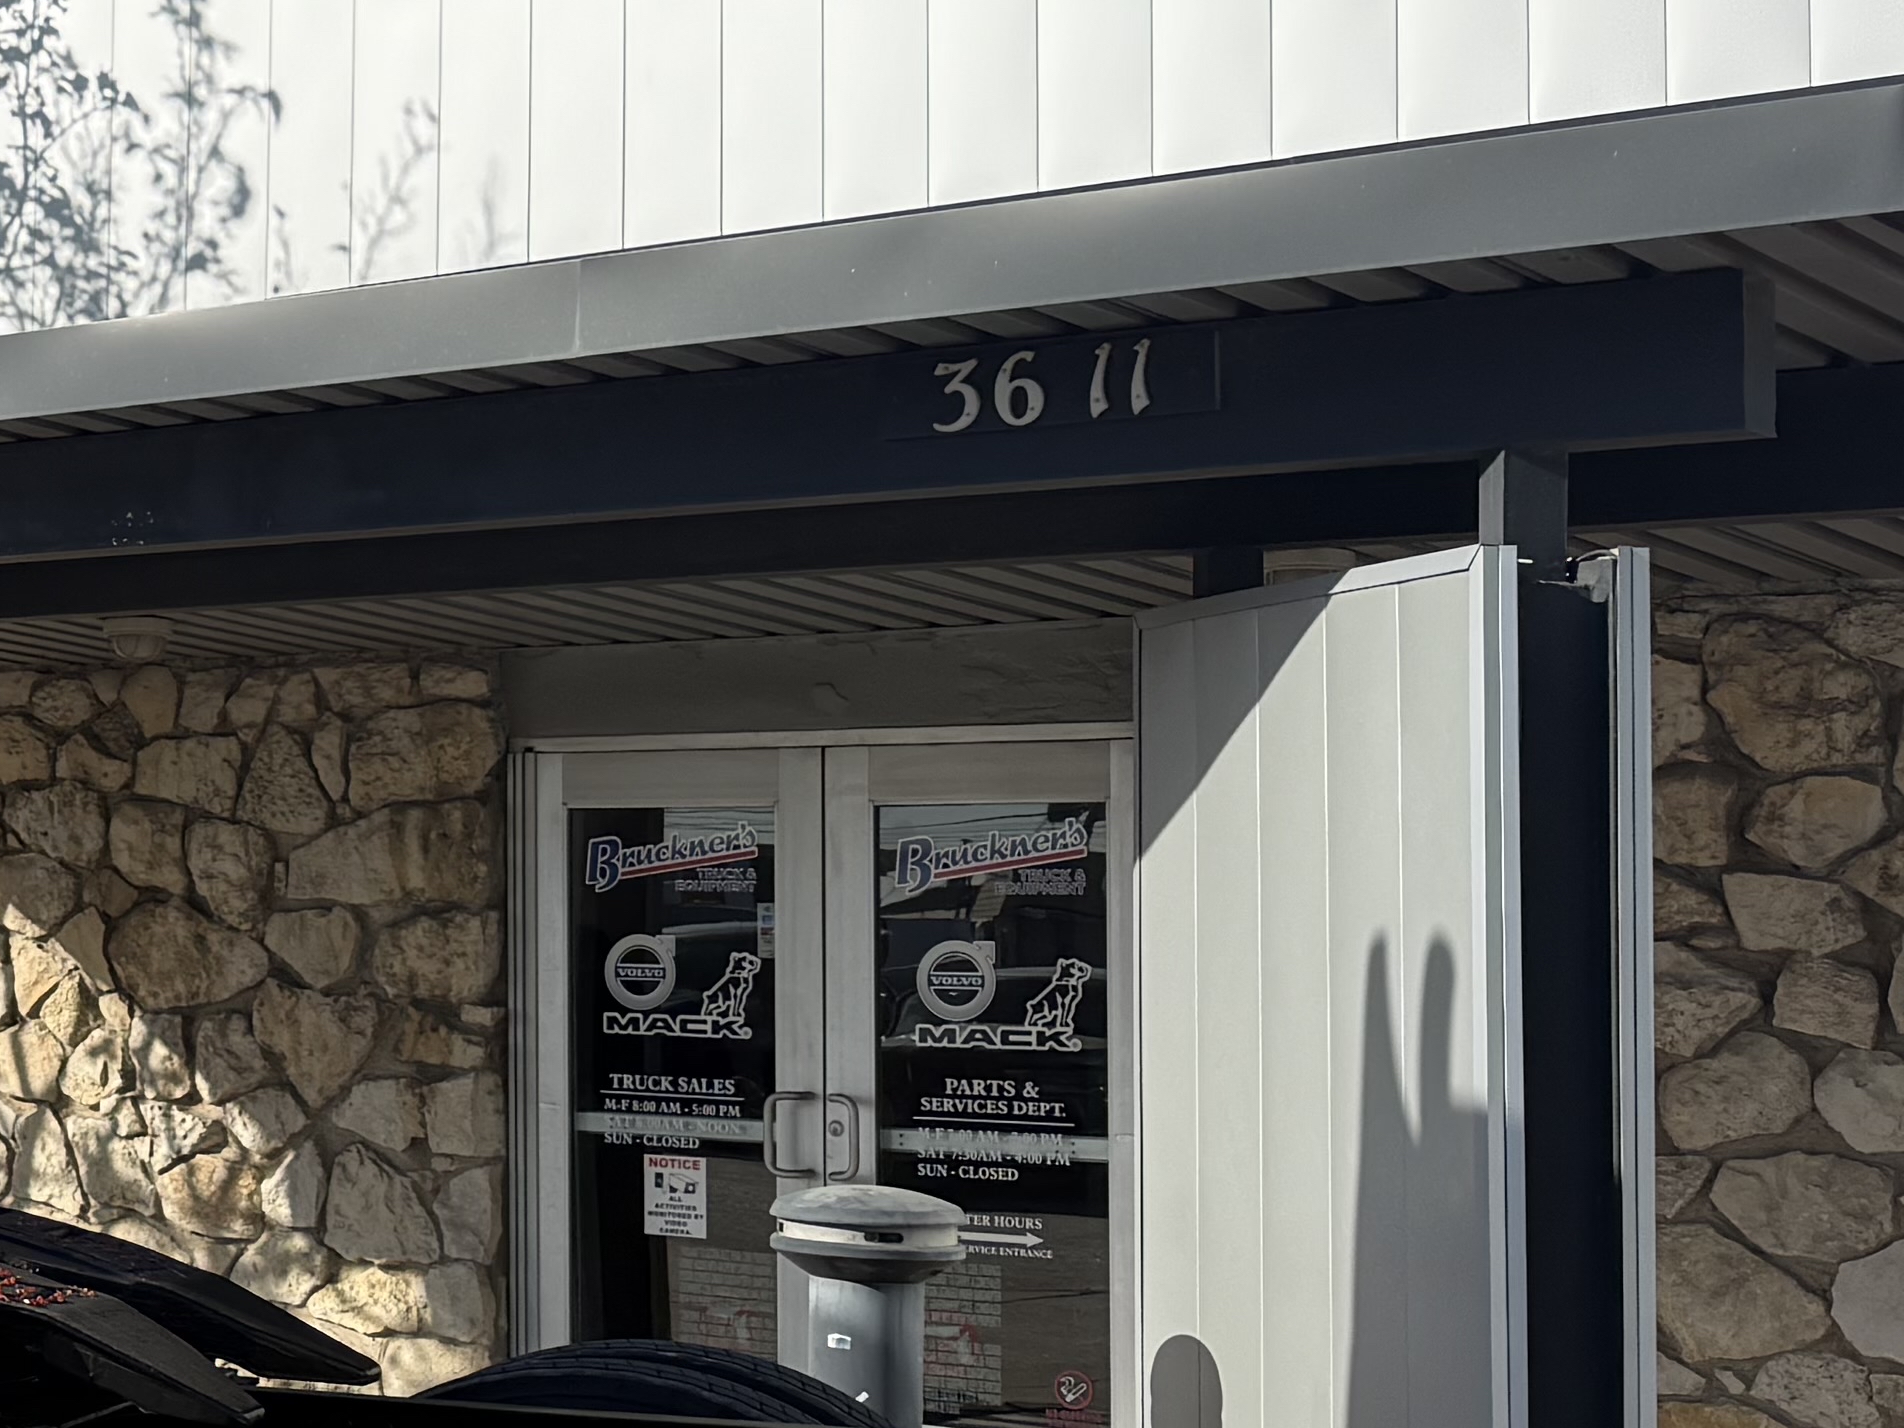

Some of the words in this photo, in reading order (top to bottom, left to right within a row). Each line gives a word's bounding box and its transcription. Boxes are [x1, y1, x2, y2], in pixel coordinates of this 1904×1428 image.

[586, 821, 758, 892] Bruckner's
[895, 818, 1088, 895] Bruckner's
[696, 868, 744, 880] TRUCK
[1019, 868, 1072, 882] TRUCK
[675, 880, 757, 893] EQUIPMENT
[994, 881, 1087, 895] EQUIPMENT
[617, 968, 664, 977] VOLVO
[930, 976, 983, 986] VOLVO
[603, 1012, 746, 1039] MACK
[915, 1024, 1075, 1052] MACK
[609, 1073, 674, 1091] TRUCK
[678, 1077, 735, 1094] SALES
[944, 1078, 1016, 1096] PARTS
[1022, 1081, 1040, 1098] &
[604, 1098, 630, 1111] M-F
[632, 1100, 657, 1112] 8:00
[658, 1102, 681, 1114] AM
[692, 1104, 716, 1116] 5:00
[719, 1105, 741, 1117] PM
[920, 1097, 1008, 1115] SERVICES
[1012, 1101, 1066, 1117] DEPT.
[604, 1132, 632, 1144] SUN
[643, 1134, 699, 1148] CLOSED
[976, 1130, 999, 1143] AM
[1040, 1133, 1062, 1146] PM
[648, 1157, 701, 1171] NOTICE
[917, 1146, 945, 1159] SAT
[1046, 1152, 1071, 1166] PM
[917, 1163, 947, 1177] SUN
[959, 1165, 1019, 1181] CLOSED
[966, 1213, 991, 1226] TER
[994, 1216, 1042, 1230] HOURS
[967, 1245, 997, 1255] RVICE
[999, 1247, 1053, 1259] ENTRANCE
